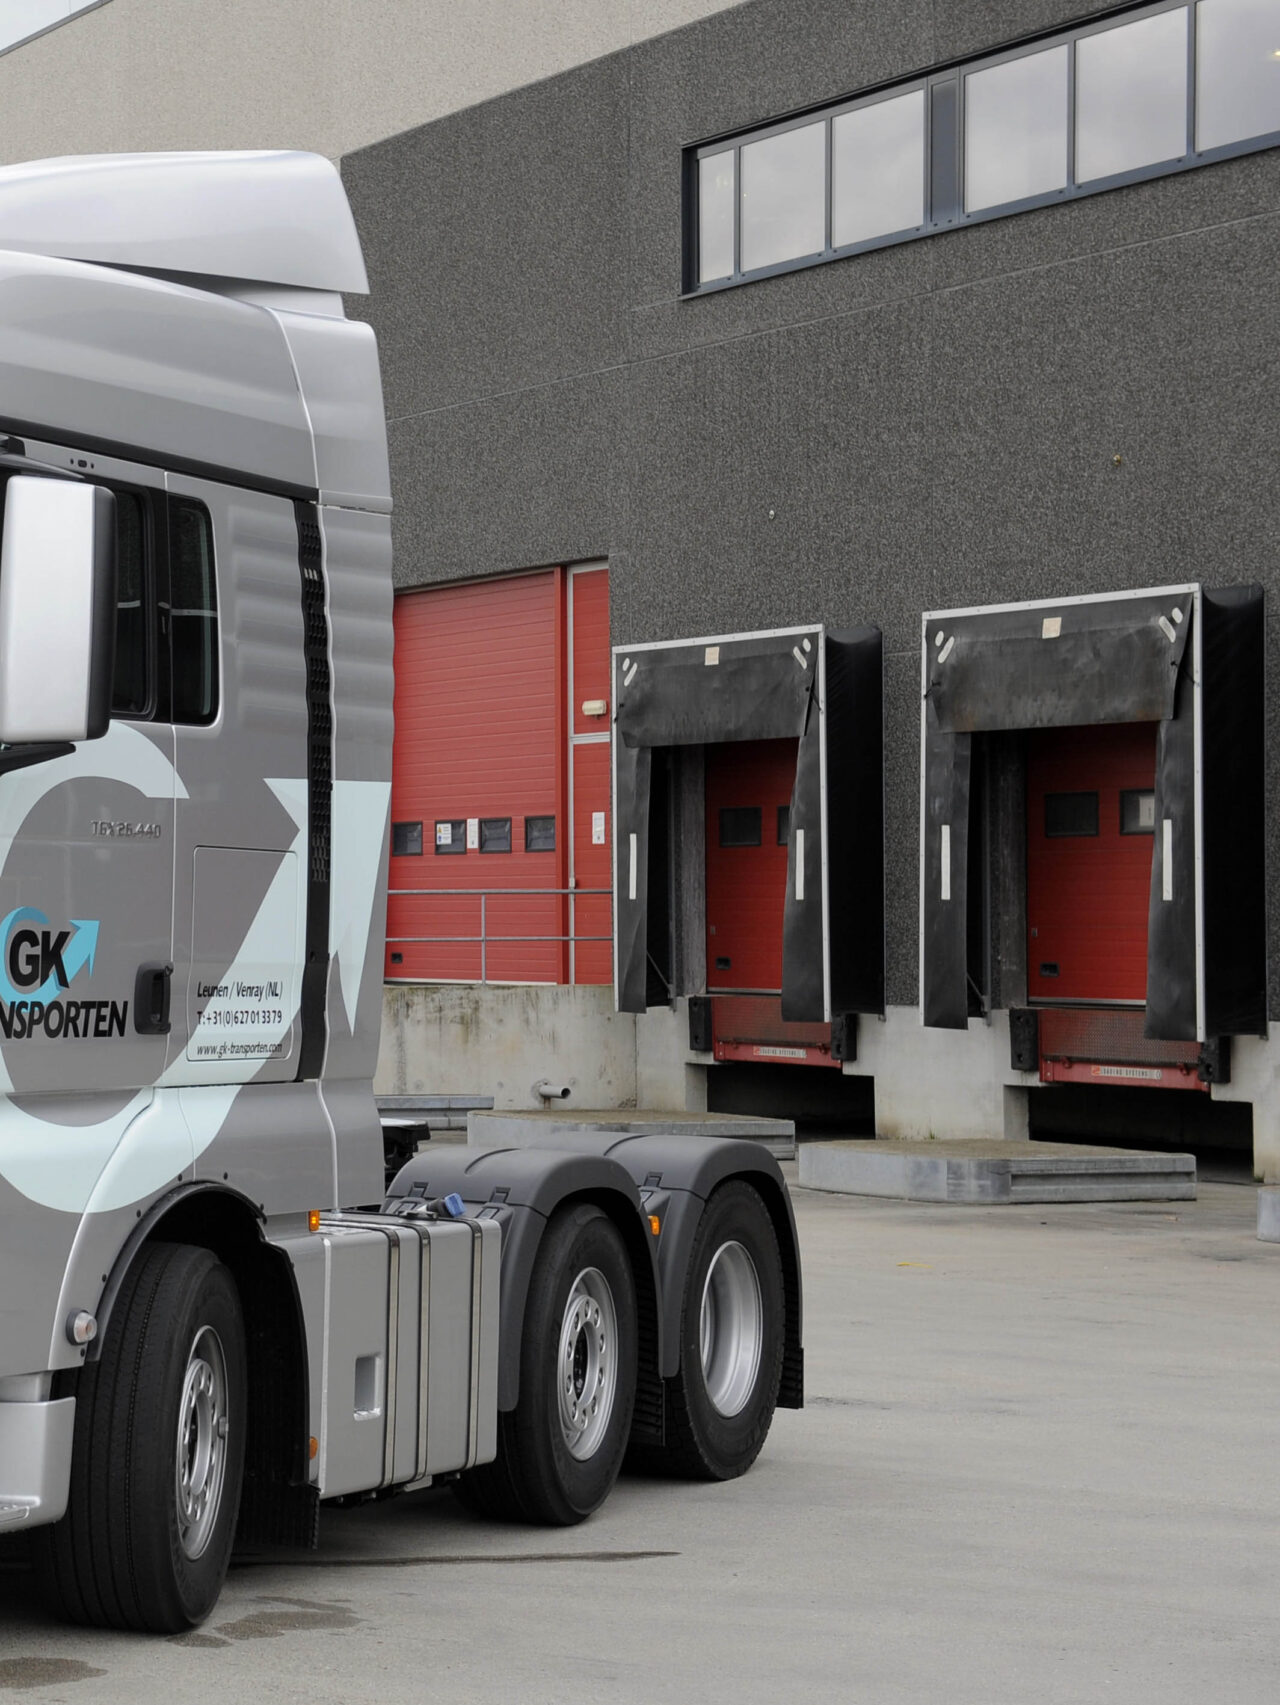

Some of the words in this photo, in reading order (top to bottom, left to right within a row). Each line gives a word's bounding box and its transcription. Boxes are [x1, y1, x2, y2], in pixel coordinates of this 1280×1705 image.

[9, 929, 71, 988] GK
[197, 982, 229, 998] Leunen
[236, 981, 265, 1002] Venray
[265, 981, 283, 1000] (NL)
[197, 1042, 282, 1058] www.gk-transporten.com
